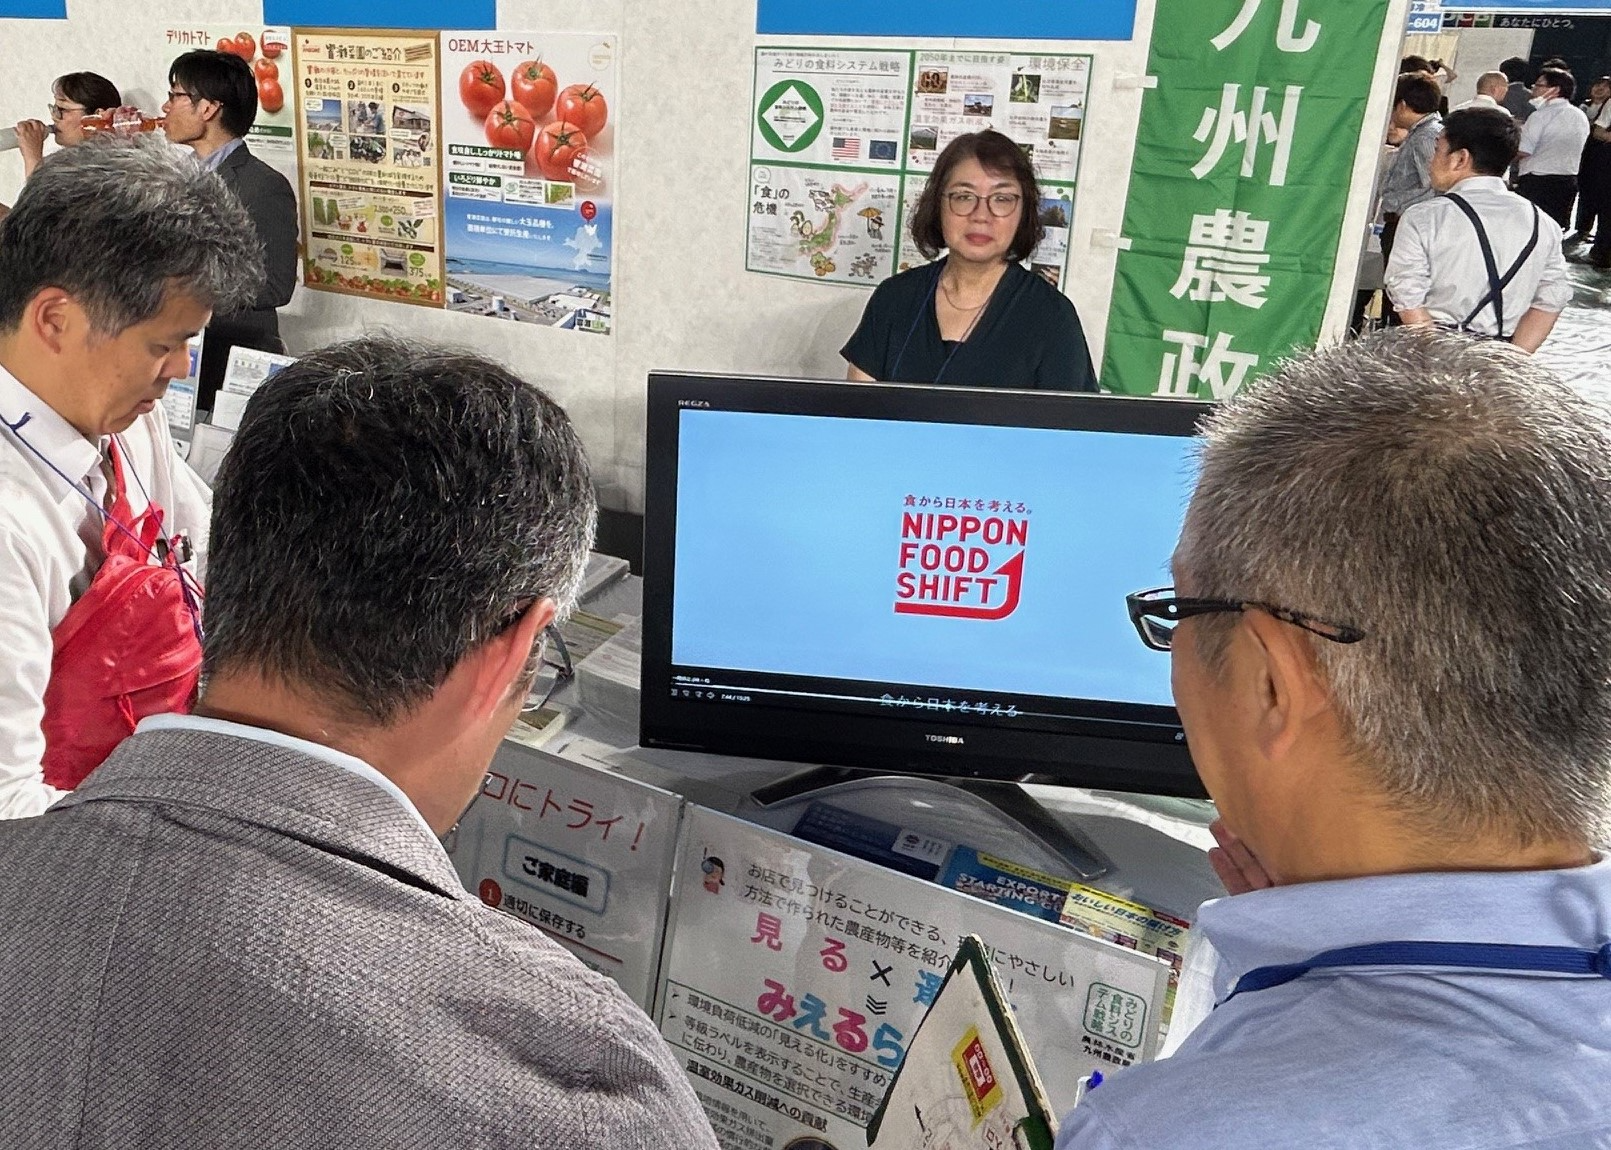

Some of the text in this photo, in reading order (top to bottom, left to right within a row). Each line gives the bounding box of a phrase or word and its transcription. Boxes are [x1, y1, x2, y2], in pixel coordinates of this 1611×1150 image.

[1500, 18, 1575, 29] あなたにひとつ。
[166, 30, 211, 45] デリカトマト
[774, 58, 901, 73] みどりの食料システム戦略
[1029, 57, 1086, 71] 環境保全
[753, 185, 790, 200] 「食」の
[753, 202, 778, 216] 危機
[904, 494, 1032, 516] 食から日本を考える。
[901, 511, 1028, 547] NIPPON
[899, 542, 990, 574] FOOD
[896, 572, 998, 604] SHIFT
[925, 734, 964, 744] TOSHIBA
[522, 855, 590, 898] ご家庭編
[504, 893, 586, 939] 適切に保存する
[1120, 997, 1138, 1042] みどりの
[683, 1014, 881, 1109] 等級ラベルを表示することで、生産
[686, 1058, 828, 1133] 温室効果ガス削減への貢献
